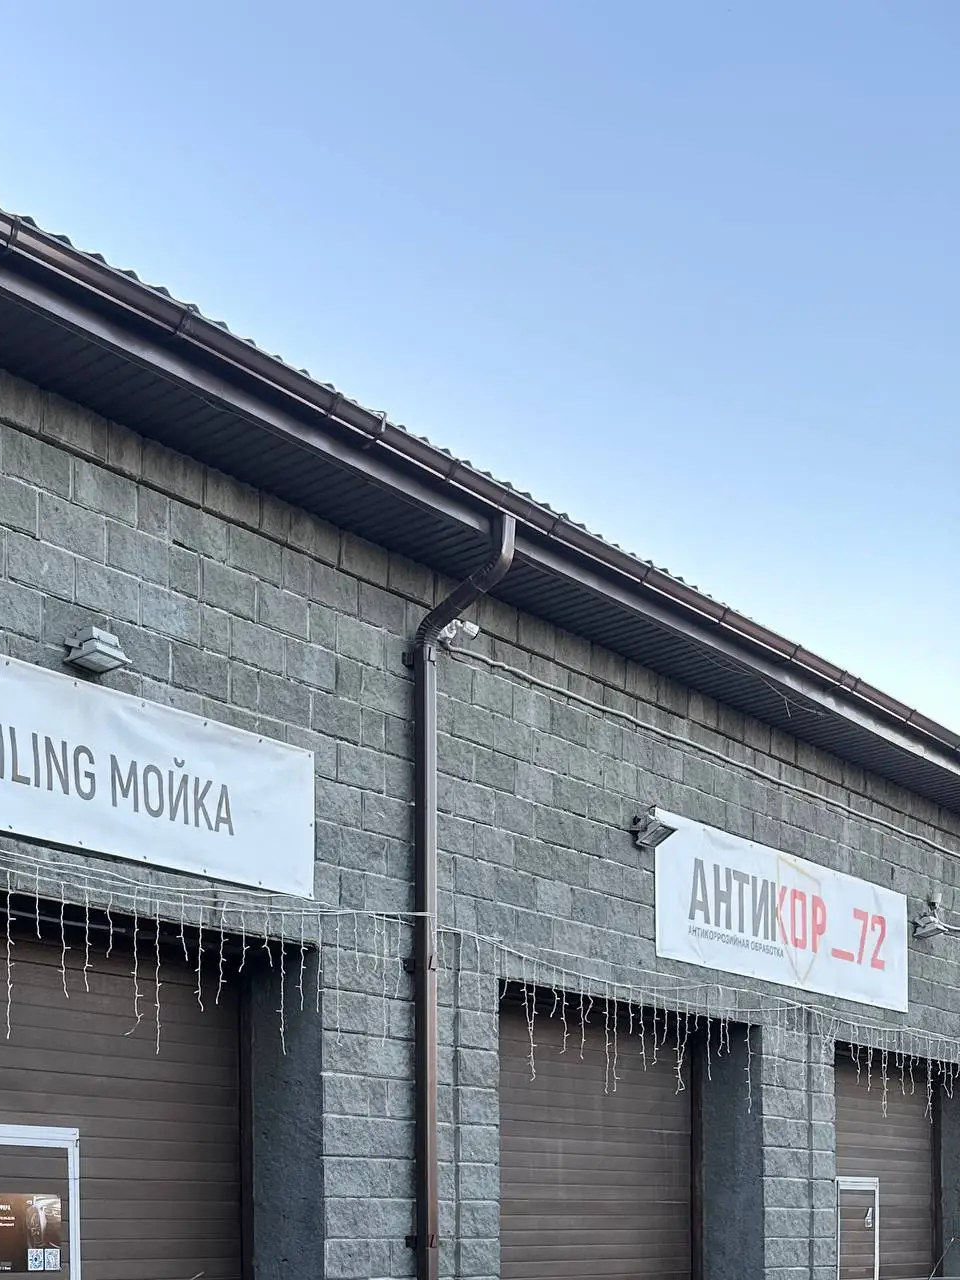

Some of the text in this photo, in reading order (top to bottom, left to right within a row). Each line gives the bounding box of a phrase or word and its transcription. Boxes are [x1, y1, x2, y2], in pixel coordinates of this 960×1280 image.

[110, 754, 235, 837] МОЙКА
[688, 925, 784, 958] АНТИКОРРОЗИЙНАЯ ОБРАБОТКА
